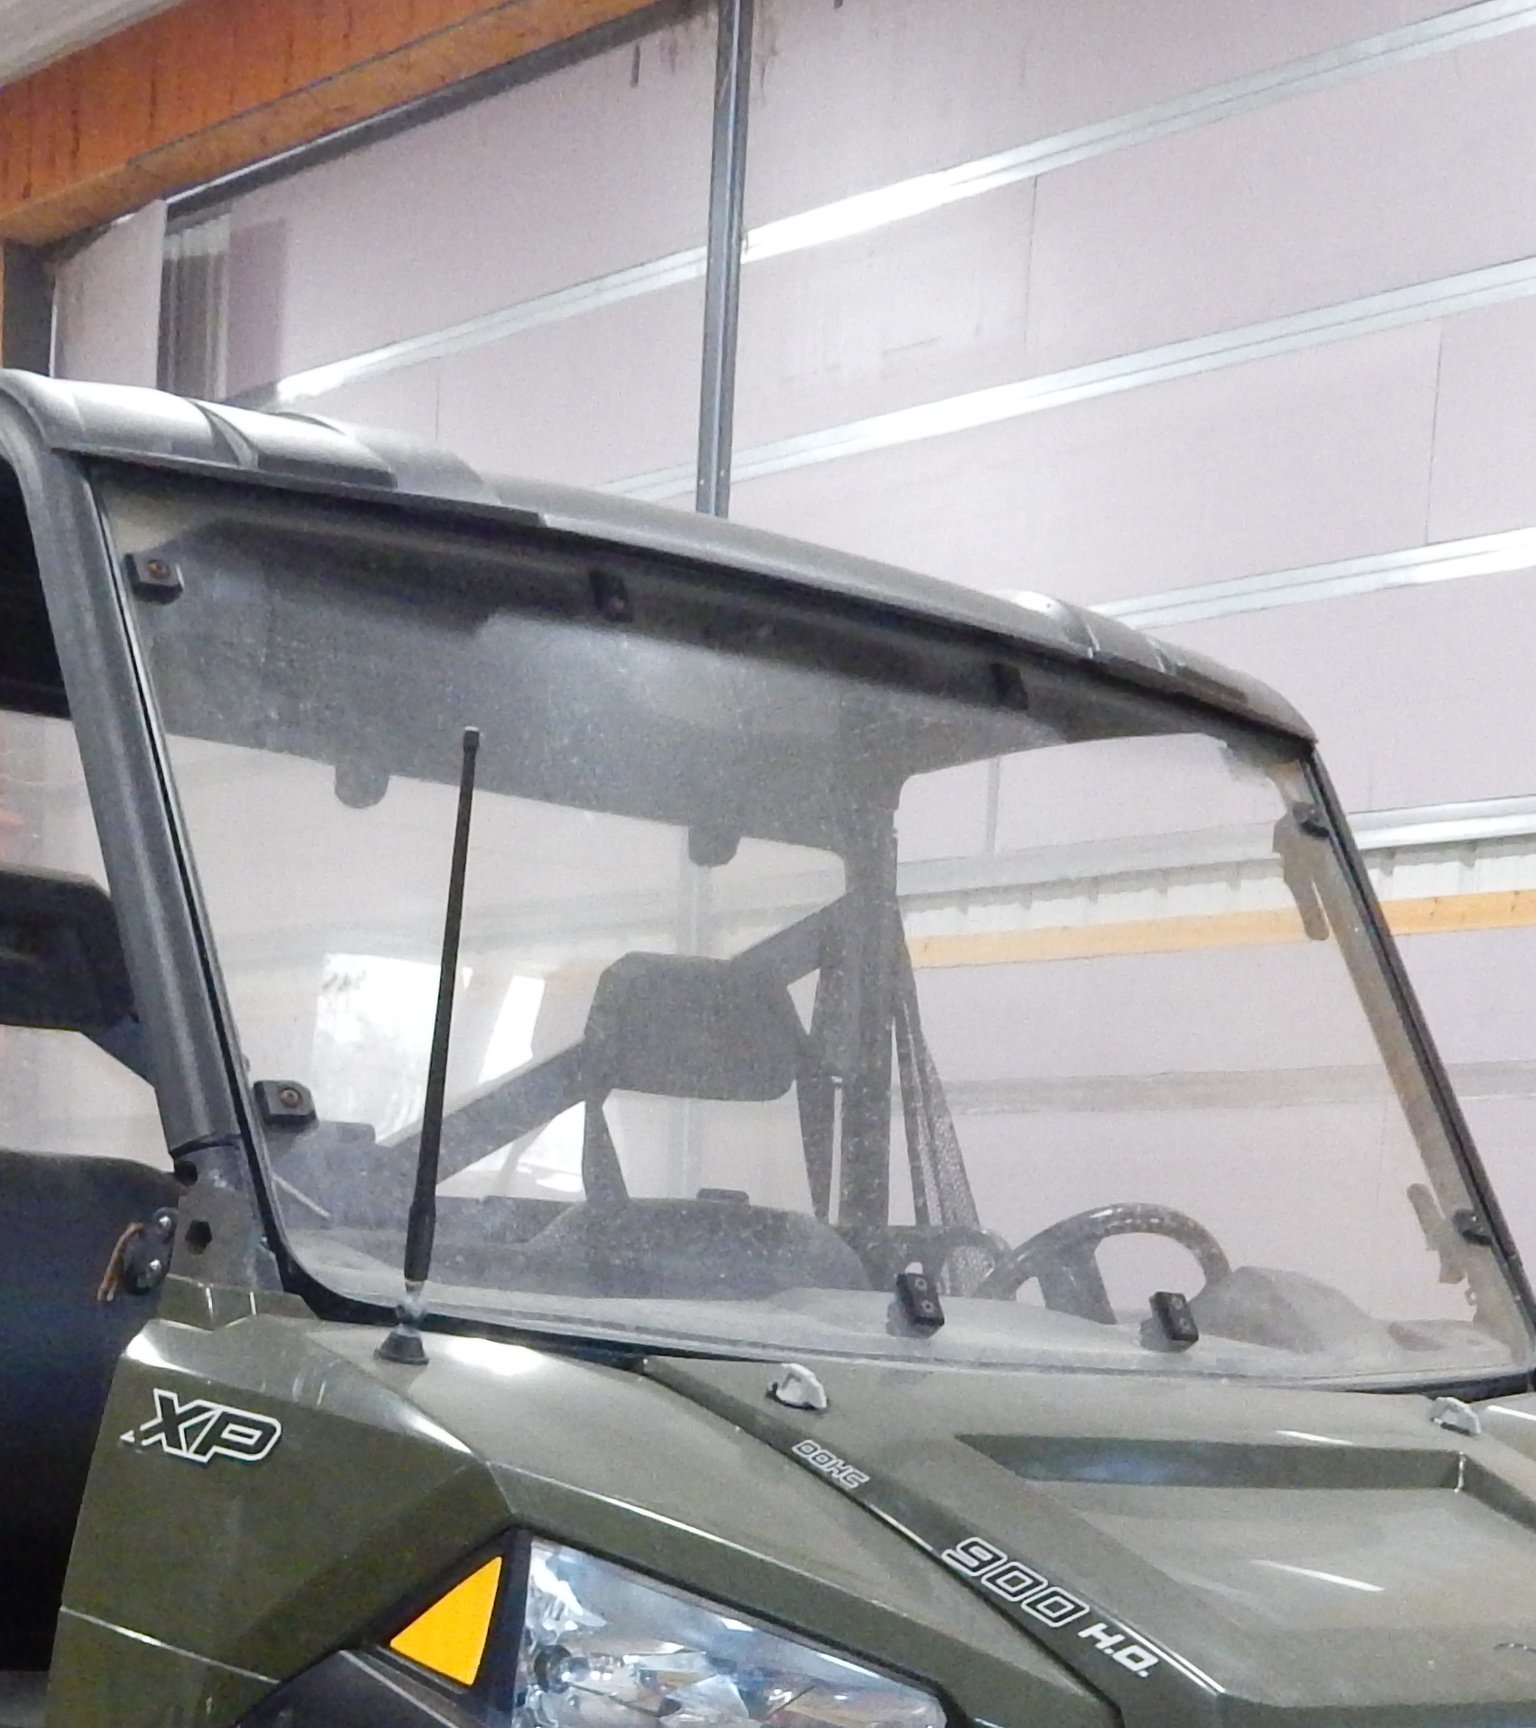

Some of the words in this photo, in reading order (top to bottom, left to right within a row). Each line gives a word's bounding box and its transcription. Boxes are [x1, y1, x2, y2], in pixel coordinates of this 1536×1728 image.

[120, 1387, 282, 1463] XP
[941, 1536, 1090, 1628] 900
[1077, 1622, 1159, 1678] H.O.
